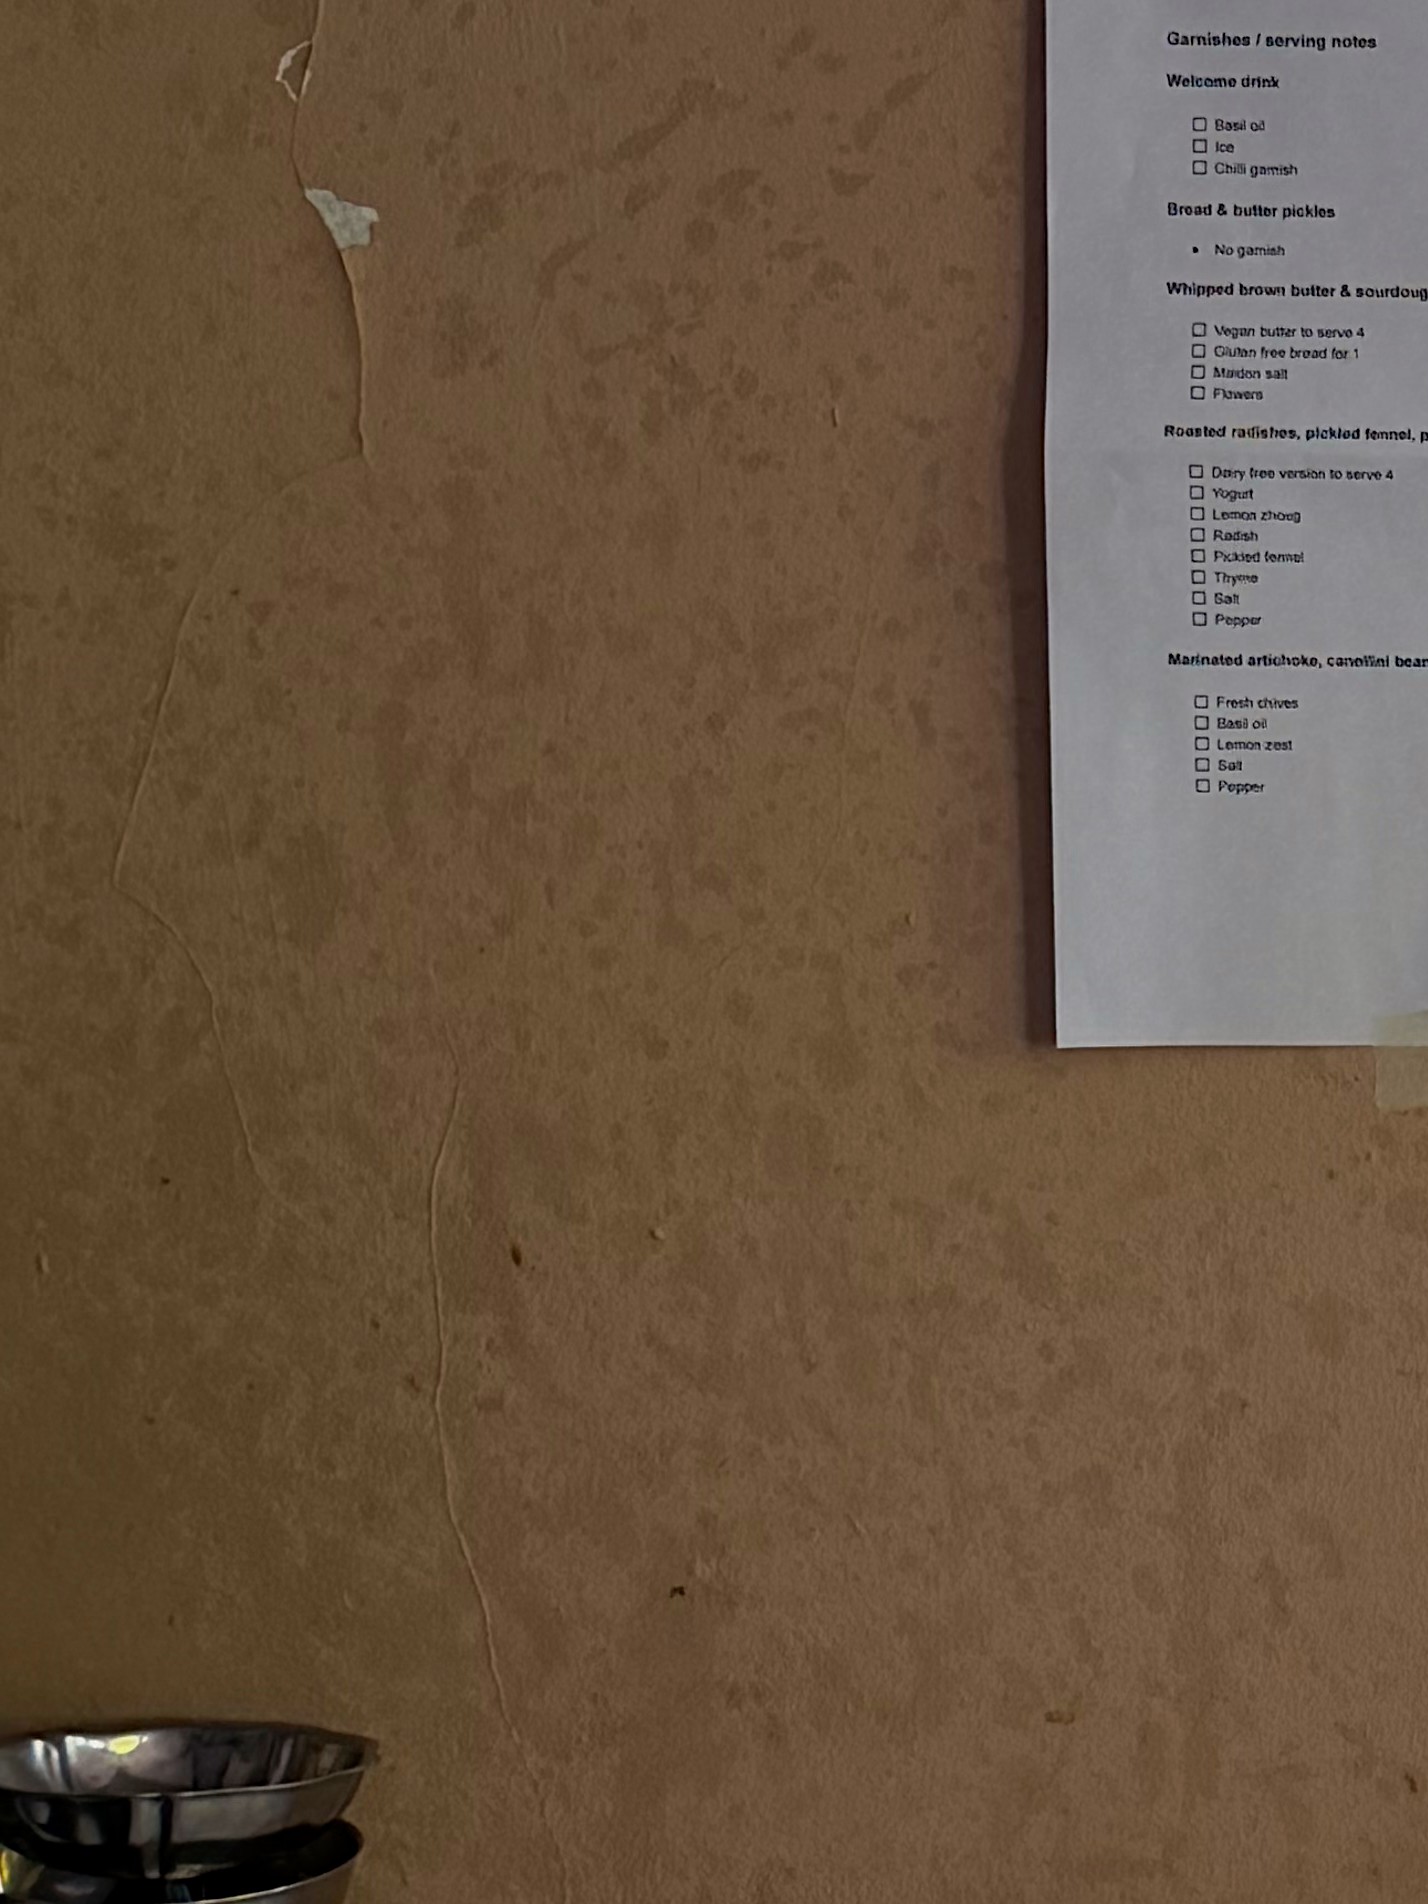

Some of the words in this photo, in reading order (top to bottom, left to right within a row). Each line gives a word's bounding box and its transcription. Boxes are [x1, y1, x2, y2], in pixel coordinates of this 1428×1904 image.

[1167, 31, 1250, 47] Garnishes
[1256, 33, 1261, 47] /
[1266, 34, 1326, 51] serving
[1332, 36, 1377, 49] notes
[1166, 73, 1237, 88] Welcome
[1241, 74, 1280, 88] drink
[1215, 118, 1246, 131] Basil
[1250, 120, 1265, 132] oil
[1215, 141, 1234, 153] Ice
[1214, 162, 1246, 174] Chilli
[1250, 164, 1298, 178] garnish
[1168, 202, 1212, 216] Bread
[1216, 203, 1228, 216] &
[1233, 204, 1278, 217] butter
[1282, 204, 1336, 221] pickles
[1215, 244, 1234, 256] No
[1237, 244, 1285, 259] garnish
[1166, 282, 1234, 298] Whipped
[1239, 282, 1285, 296] brown
[1291, 284, 1336, 297] butter
[1340, 284, 1351, 297] &
[1214, 325, 1255, 339] Vegan
[1260, 326, 1297, 337] butter
[1300, 327, 1313, 338] to
[1317, 329, 1353, 339] serve
[1356, 327, 1365, 338] 4
[1214, 345, 1256, 358] Gluten
[1261, 346, 1286, 359] free
[1290, 346, 1327, 359] bread
[1331, 347, 1350, 360] for
[1265, 368, 1288, 380] salt
[1213, 387, 1263, 400] Flowers
[1164, 425, 1226, 438] Roasted
[1306, 426, 1360, 441] pickled
[1212, 466, 1245, 481] Dairy
[1249, 467, 1275, 479] free
[1278, 468, 1325, 479] version
[1329, 469, 1343, 480] to
[1346, 470, 1382, 480] serve
[1385, 469, 1393, 480] 4
[1212, 488, 1253, 502] Yogurt
[1213, 508, 1256, 521] Lemon
[1213, 529, 1258, 542] Radish
[1214, 550, 1260, 563] Pickled
[1264, 550, 1304, 563] fennel
[1214, 592, 1240, 605] Salt
[1215, 613, 1262, 629] Pepper
[1168, 653, 1243, 666] Marinated
[1217, 696, 1253, 709] Fresh
[1257, 697, 1299, 709] chives
[1217, 717, 1248, 729] Basil
[1252, 718, 1267, 729] oil
[1217, 738, 1261, 751] Lemon
[1263, 740, 1293, 751] zest
[1218, 759, 1242, 771] Salt
[1218, 780, 1265, 795] Pepper
